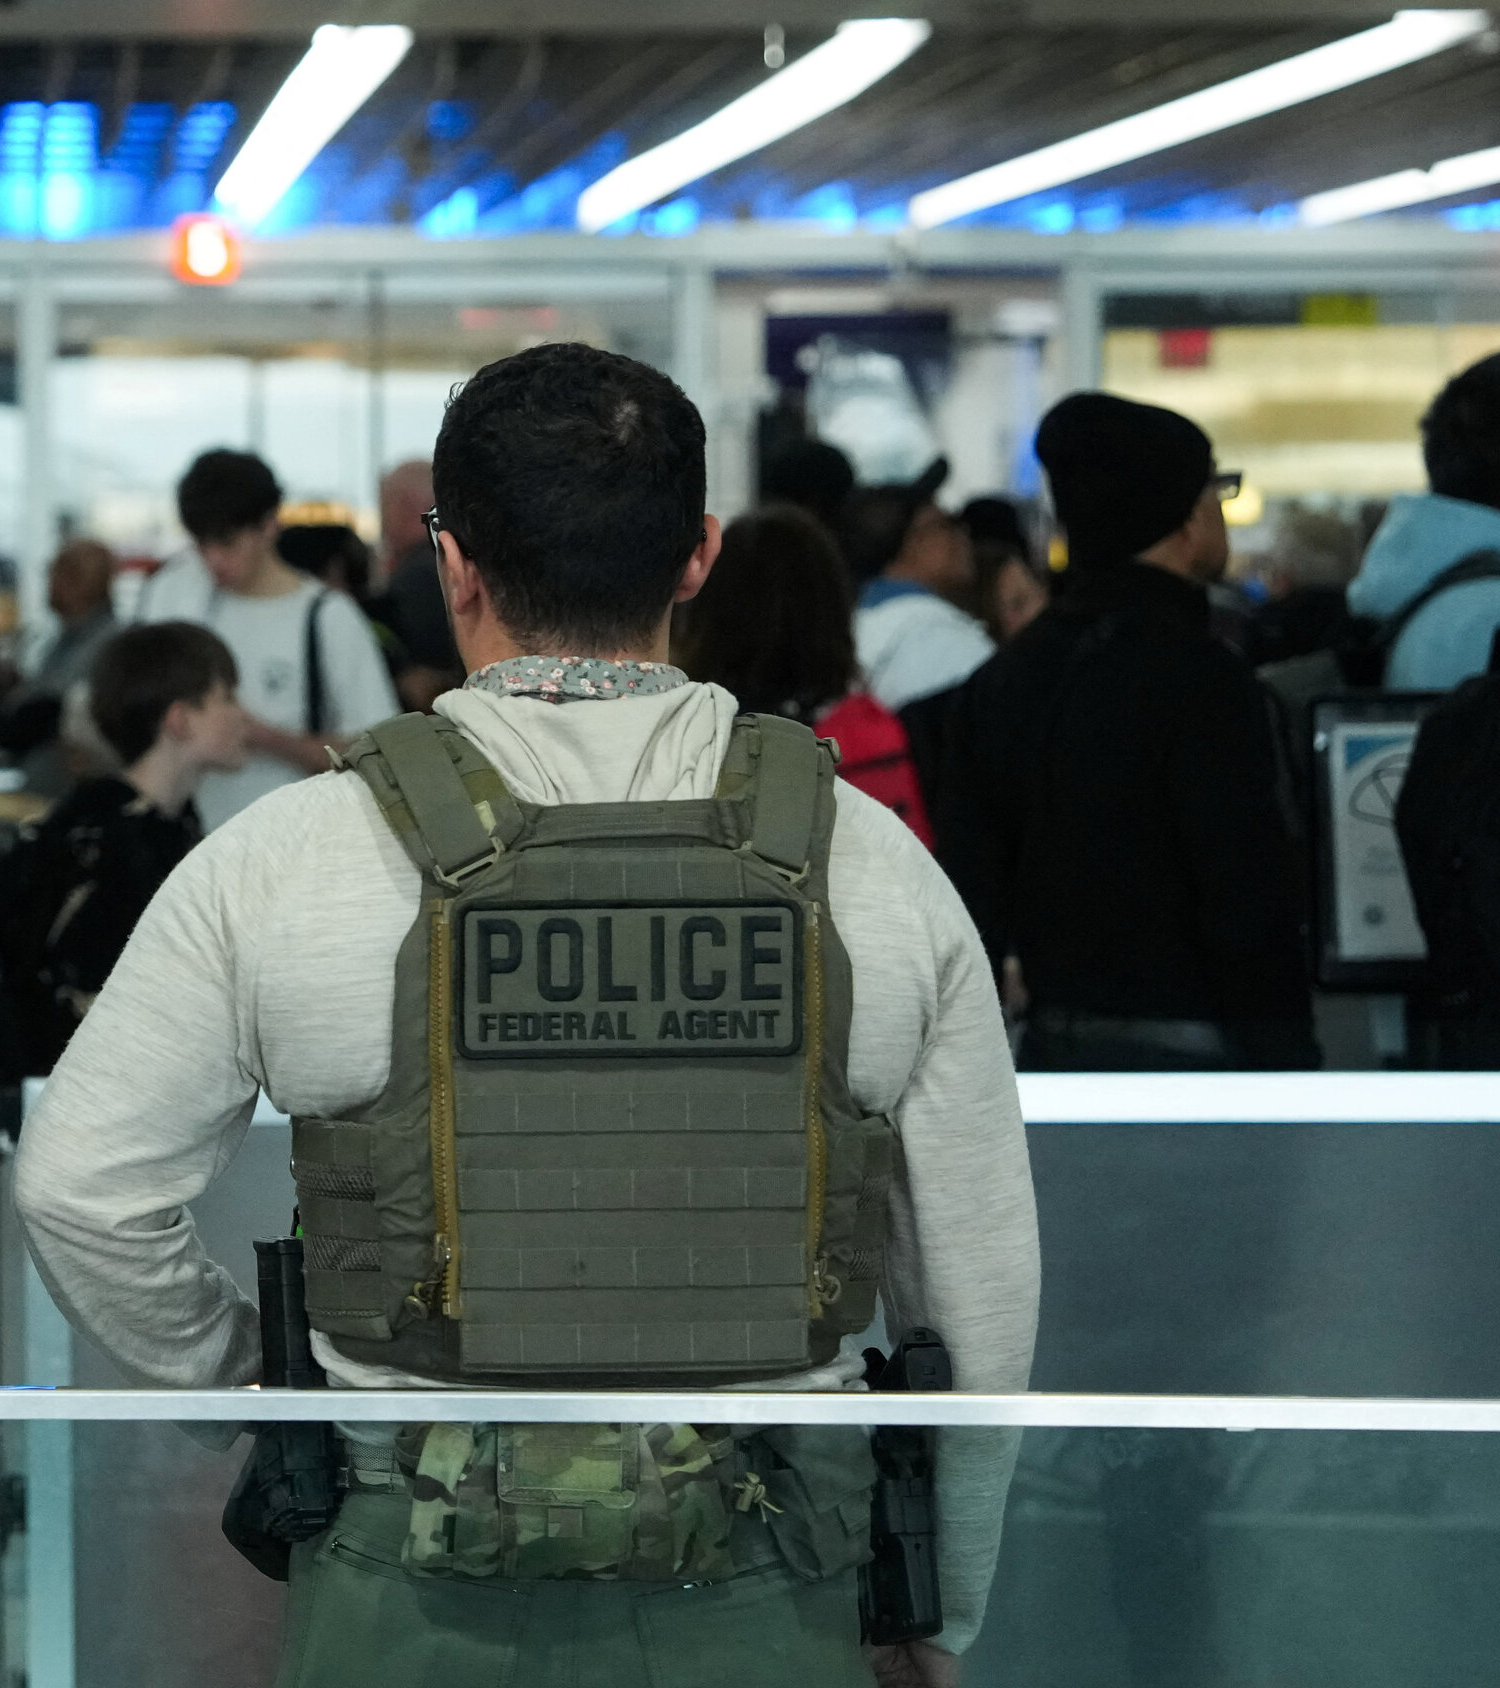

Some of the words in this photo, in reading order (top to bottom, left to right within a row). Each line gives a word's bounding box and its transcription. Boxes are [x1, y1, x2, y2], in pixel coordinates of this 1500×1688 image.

[477, 915, 783, 1003] POLICE
[478, 1011, 636, 1042] FEDERAL
[657, 1010, 780, 1040] AGENT
